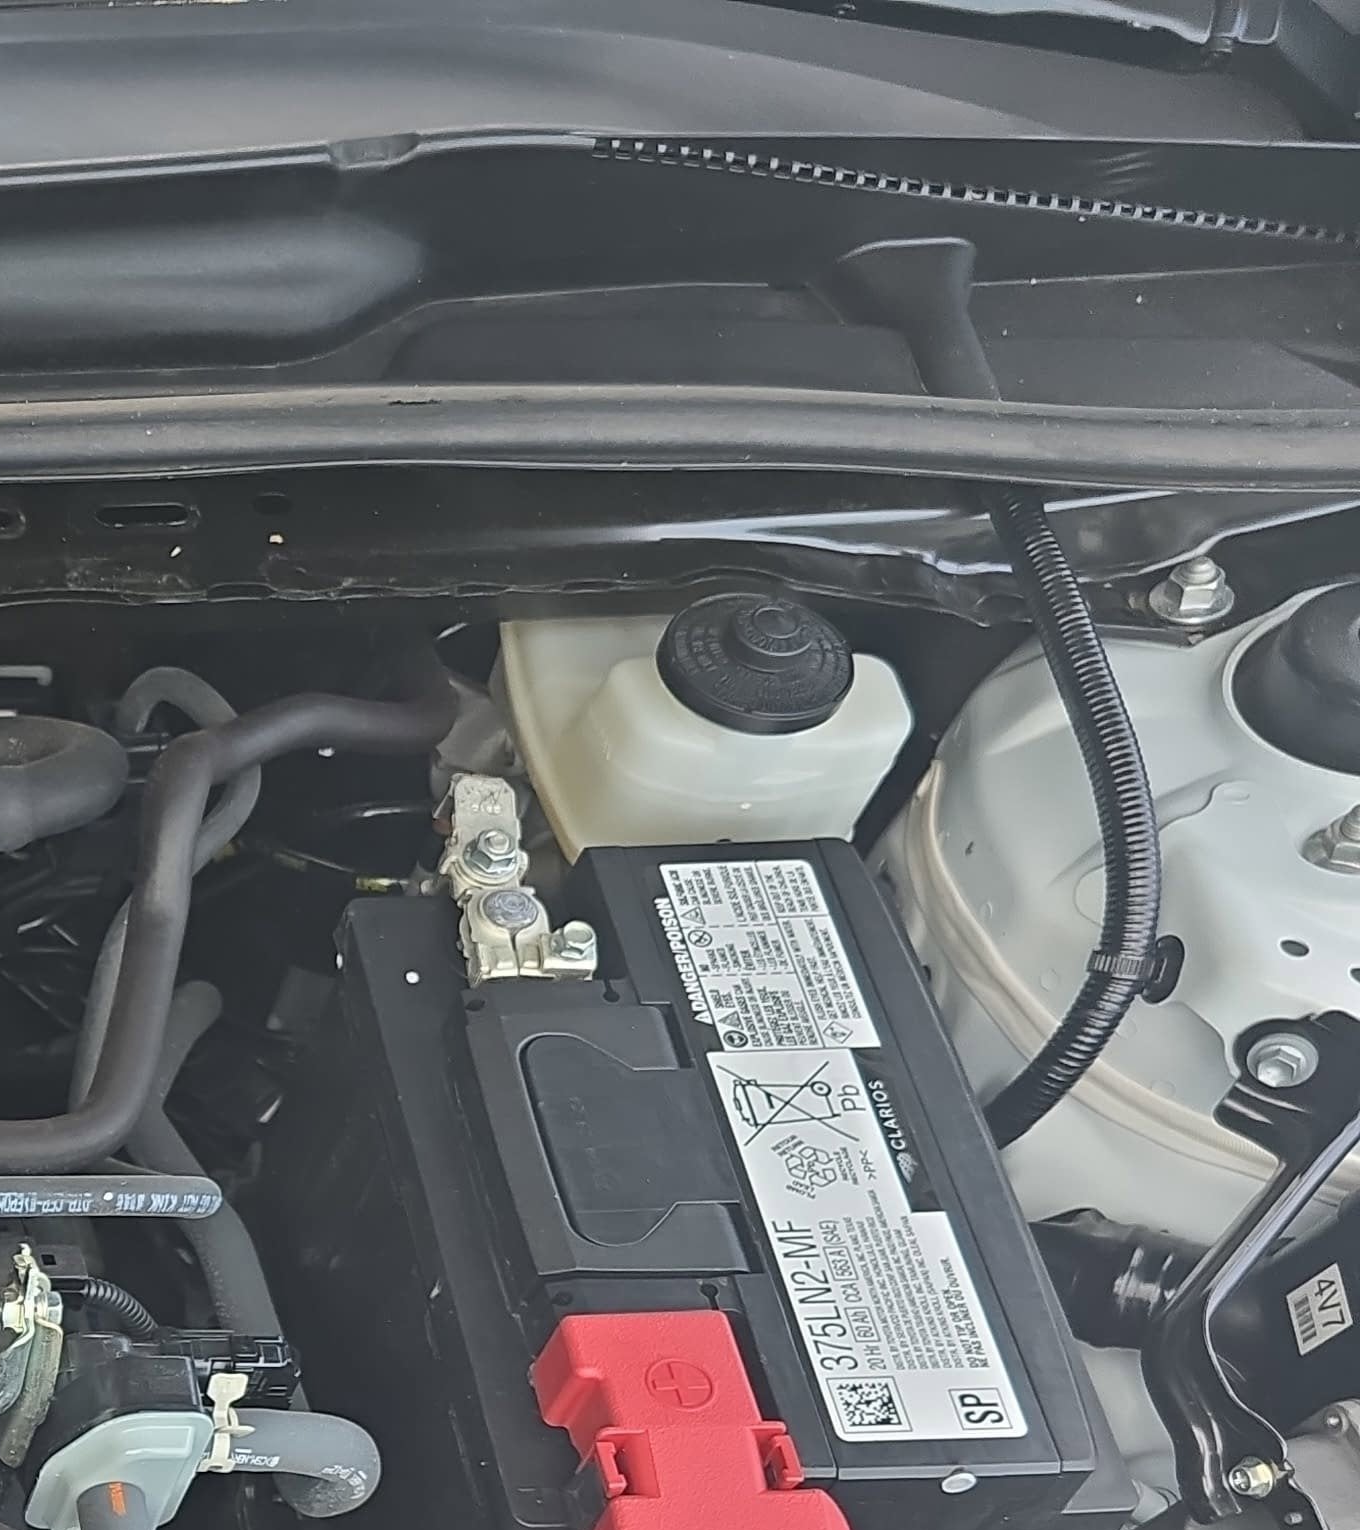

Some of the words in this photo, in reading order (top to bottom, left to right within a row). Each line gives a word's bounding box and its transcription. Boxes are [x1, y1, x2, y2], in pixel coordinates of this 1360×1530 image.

[652, 896, 709, 1012] DANGER/POISON
[836, 1085, 866, 1110] Pb
[868, 1080, 905, 1149] CLARIOS
[815, 1219, 844, 1245] (SAE)
[828, 1258, 853, 1277] 563
[770, 1219, 860, 1371] 375LN2-MF
[838, 1282, 863, 1302] CCA
[950, 1289, 965, 1301] OU
[1314, 1279, 1345, 1328] 4V7
[847, 1309, 869, 1323] Ah
[948, 1311, 963, 1322] OR
[955, 1301, 979, 1338] INCLINER
[853, 1324, 875, 1337] 60
[953, 1324, 968, 1337] TIP
[860, 1344, 881, 1356] Hr
[958, 1338, 975, 1355] NOT
[969, 1339, 985, 1355] PAS
[866, 1356, 887, 1370] 20
[964, 1355, 980, 1368] DO
[976, 1357, 990, 1368] NE
[955, 1392, 1005, 1423] SP
